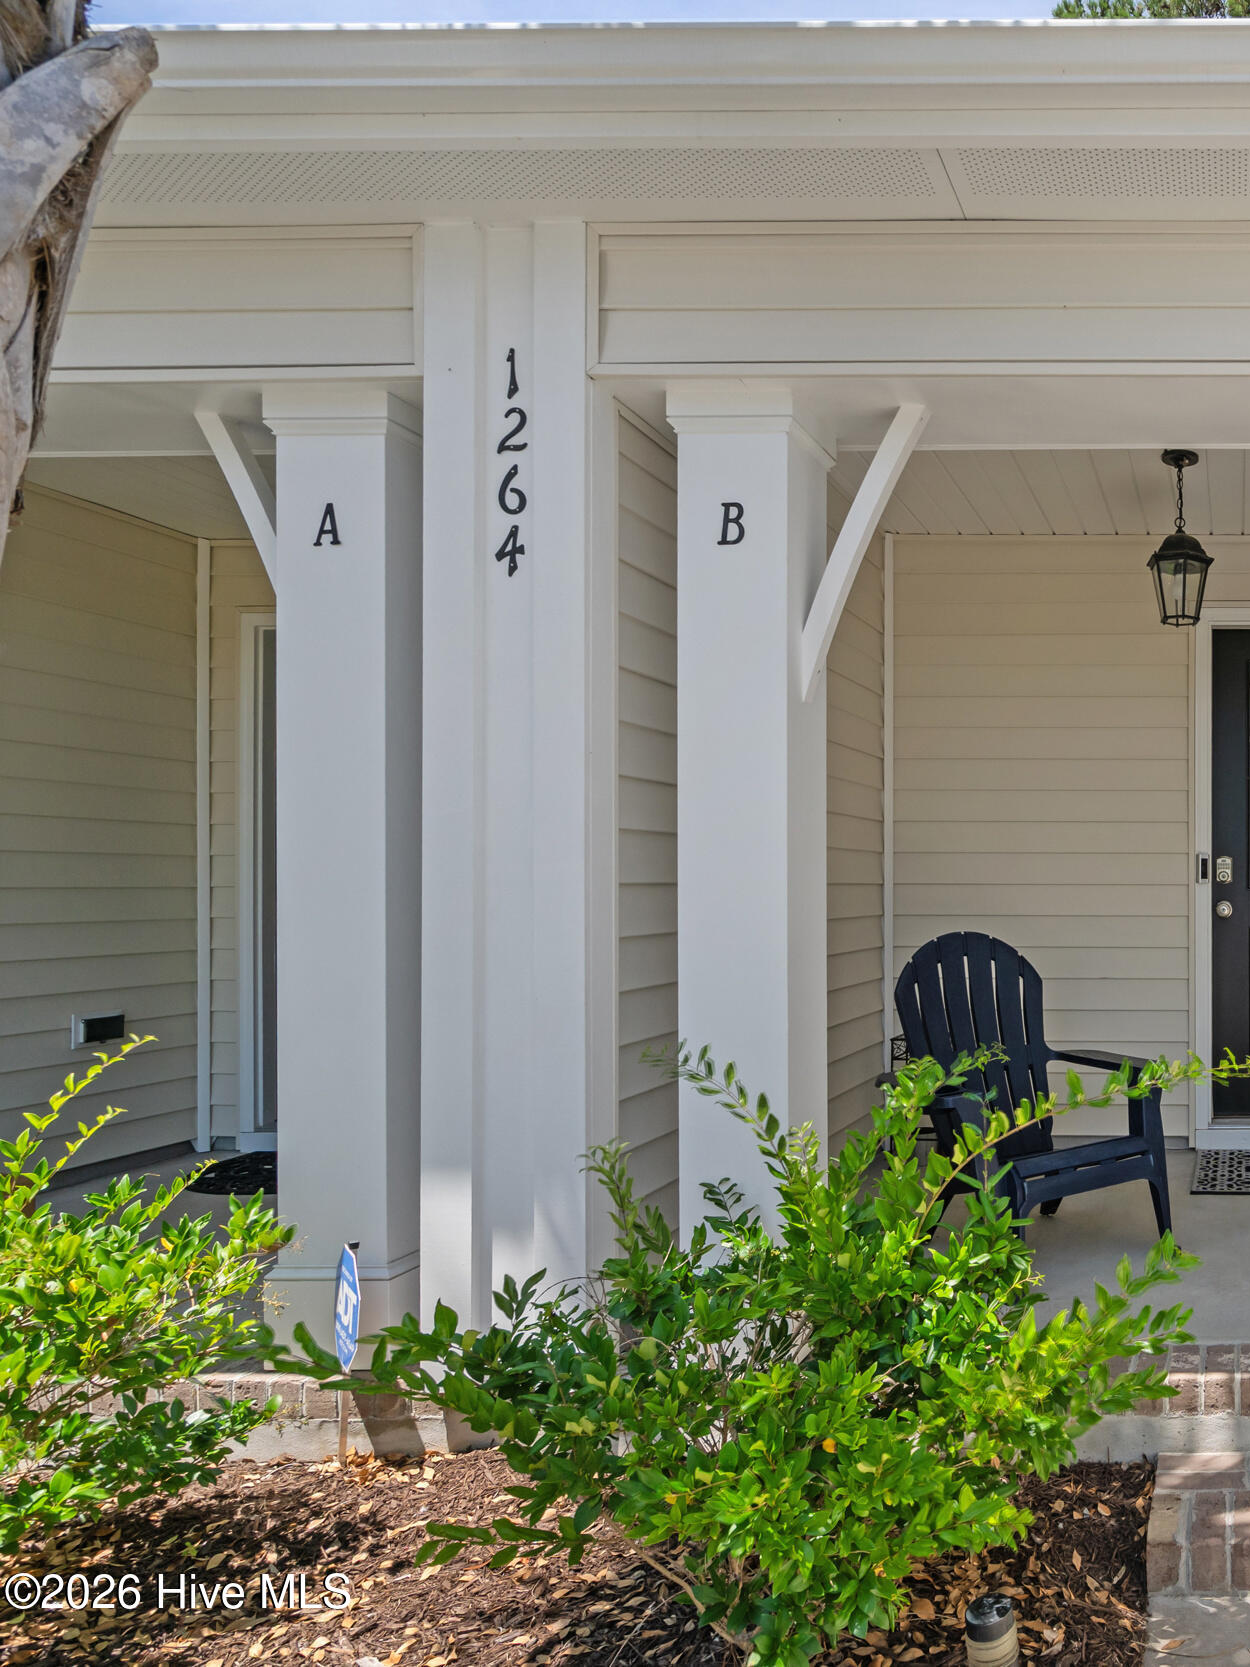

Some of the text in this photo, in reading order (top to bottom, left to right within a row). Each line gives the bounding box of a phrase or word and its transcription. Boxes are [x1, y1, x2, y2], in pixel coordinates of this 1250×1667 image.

[494, 347, 528, 578] 1264
[313, 503, 341, 546] A
[717, 502, 745, 545] B
[336, 1278, 357, 1334] ADT
